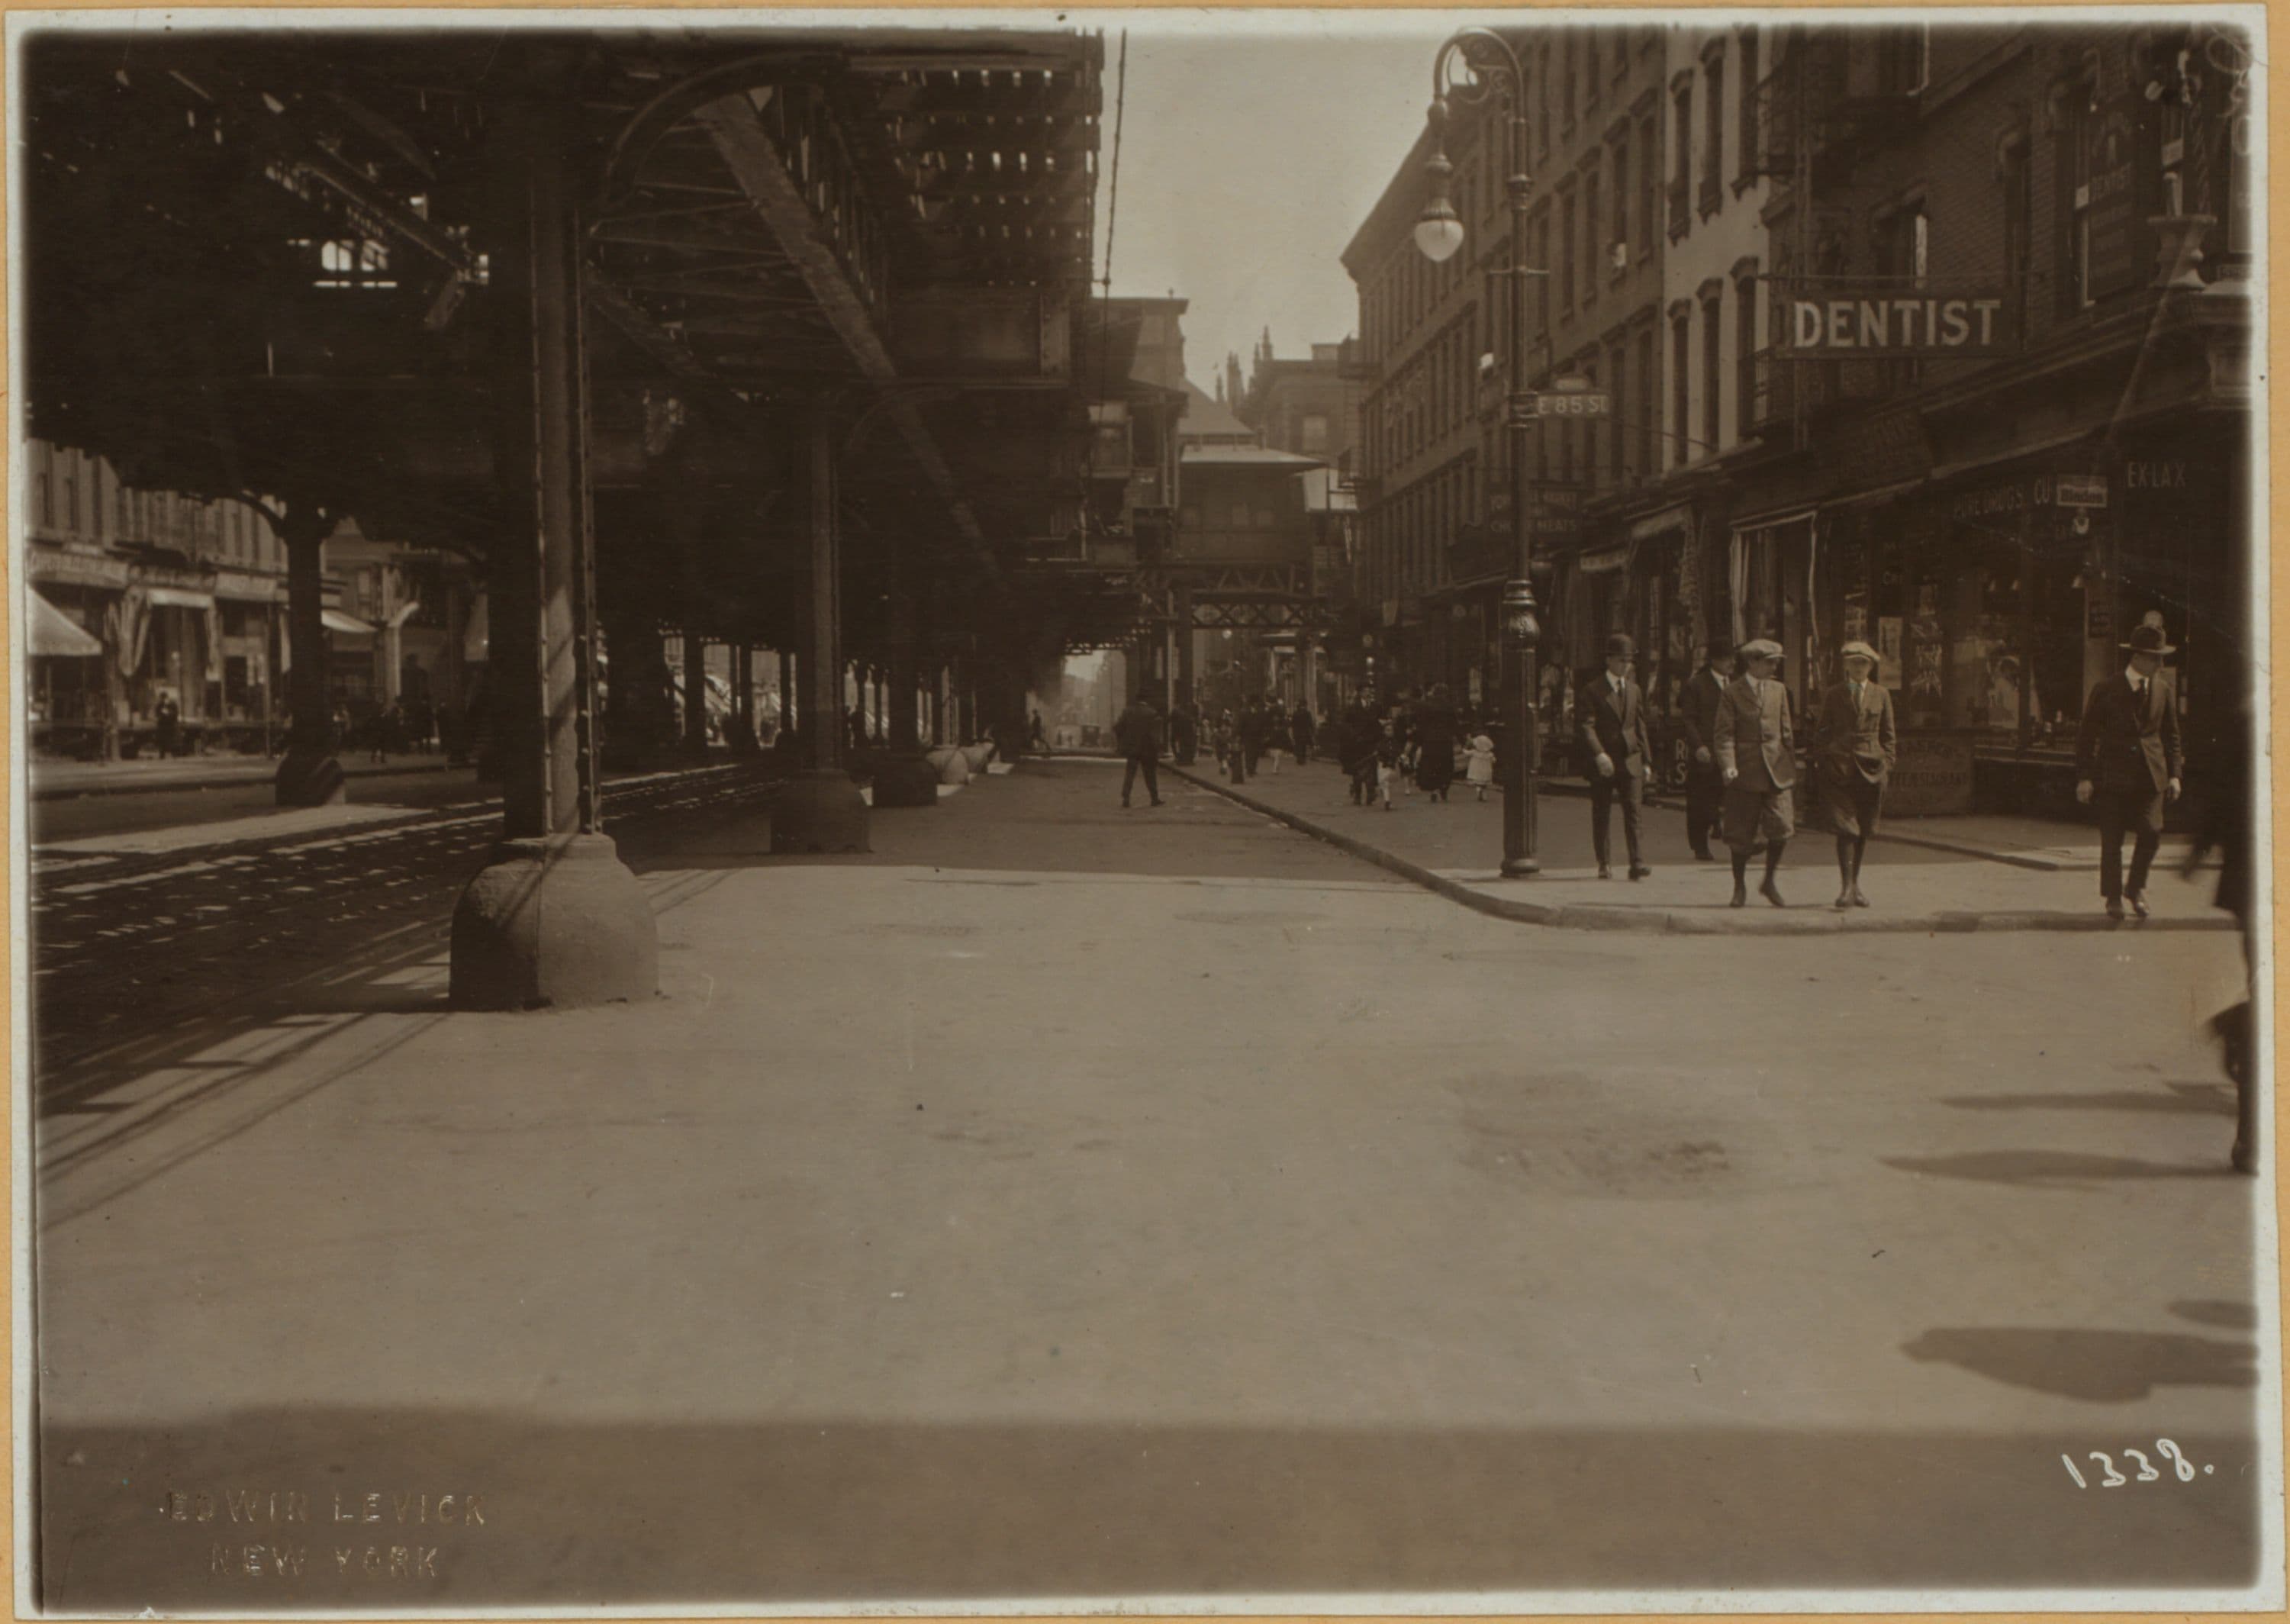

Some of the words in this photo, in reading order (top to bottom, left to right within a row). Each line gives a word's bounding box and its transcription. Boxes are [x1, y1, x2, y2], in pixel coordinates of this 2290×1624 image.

[1794, 299, 2002, 348] DENTIST
[1538, 396, 1550, 414] E
[1555, 395, 1583, 414] 85
